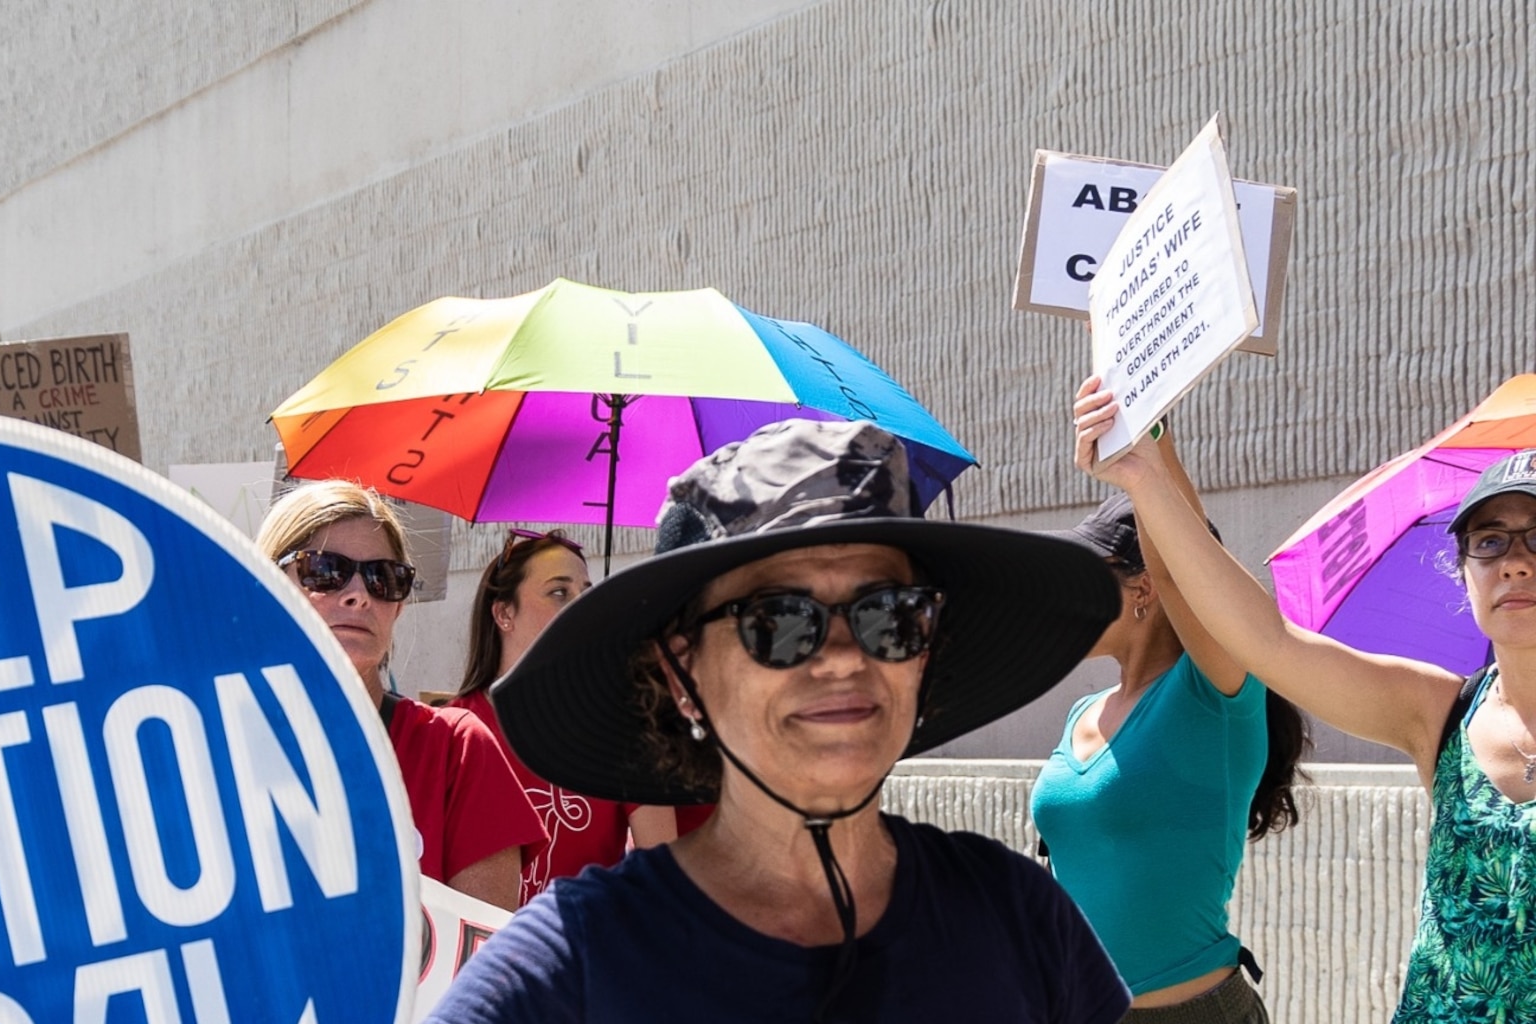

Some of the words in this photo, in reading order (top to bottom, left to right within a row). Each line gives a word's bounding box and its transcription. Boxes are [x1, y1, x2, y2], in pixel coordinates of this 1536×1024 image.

[1119, 203, 1175, 277] JUSTICE
[1164, 210, 1202, 258] WIFE
[1115, 296, 1176, 363] OVERTHROW
[1178, 273, 1202, 299] THE
[1118, 276, 1172, 337] CONSPIRED
[1175, 260, 1189, 278] TO
[50, 342, 119, 386] BIRTH
[1124, 385, 1138, 408] ON
[1140, 366, 1159, 393] JAN
[1161, 346, 1181, 372] 6TH
[1182, 320, 1210, 350] 2021.
[1127, 301, 1195, 377] GOVERNMENT
[13, 392, 25, 410] A
[39, 384, 100, 409] CRIME
